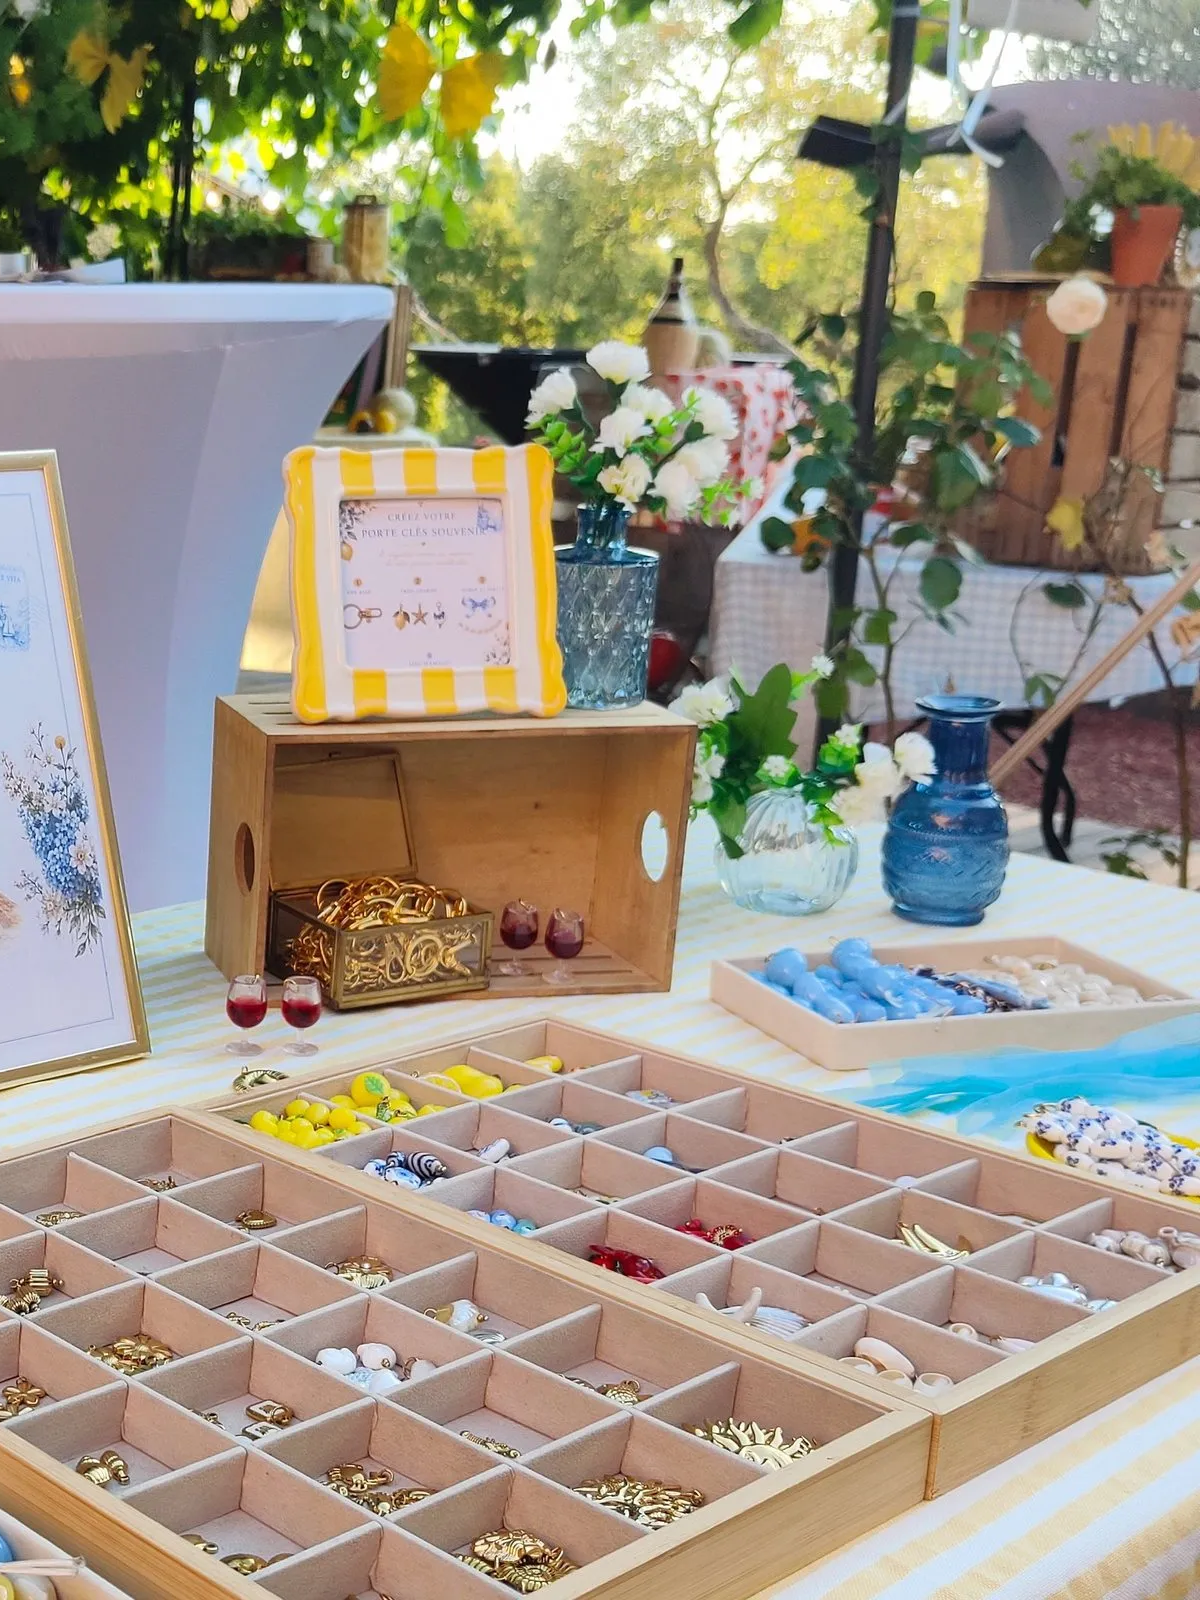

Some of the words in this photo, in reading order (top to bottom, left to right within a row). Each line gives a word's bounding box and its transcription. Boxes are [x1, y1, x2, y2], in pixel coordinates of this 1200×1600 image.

[424, 511, 456, 520] VOTRE
[361, 528, 397, 538] PORTE
[6, 575, 22, 583] VITA
